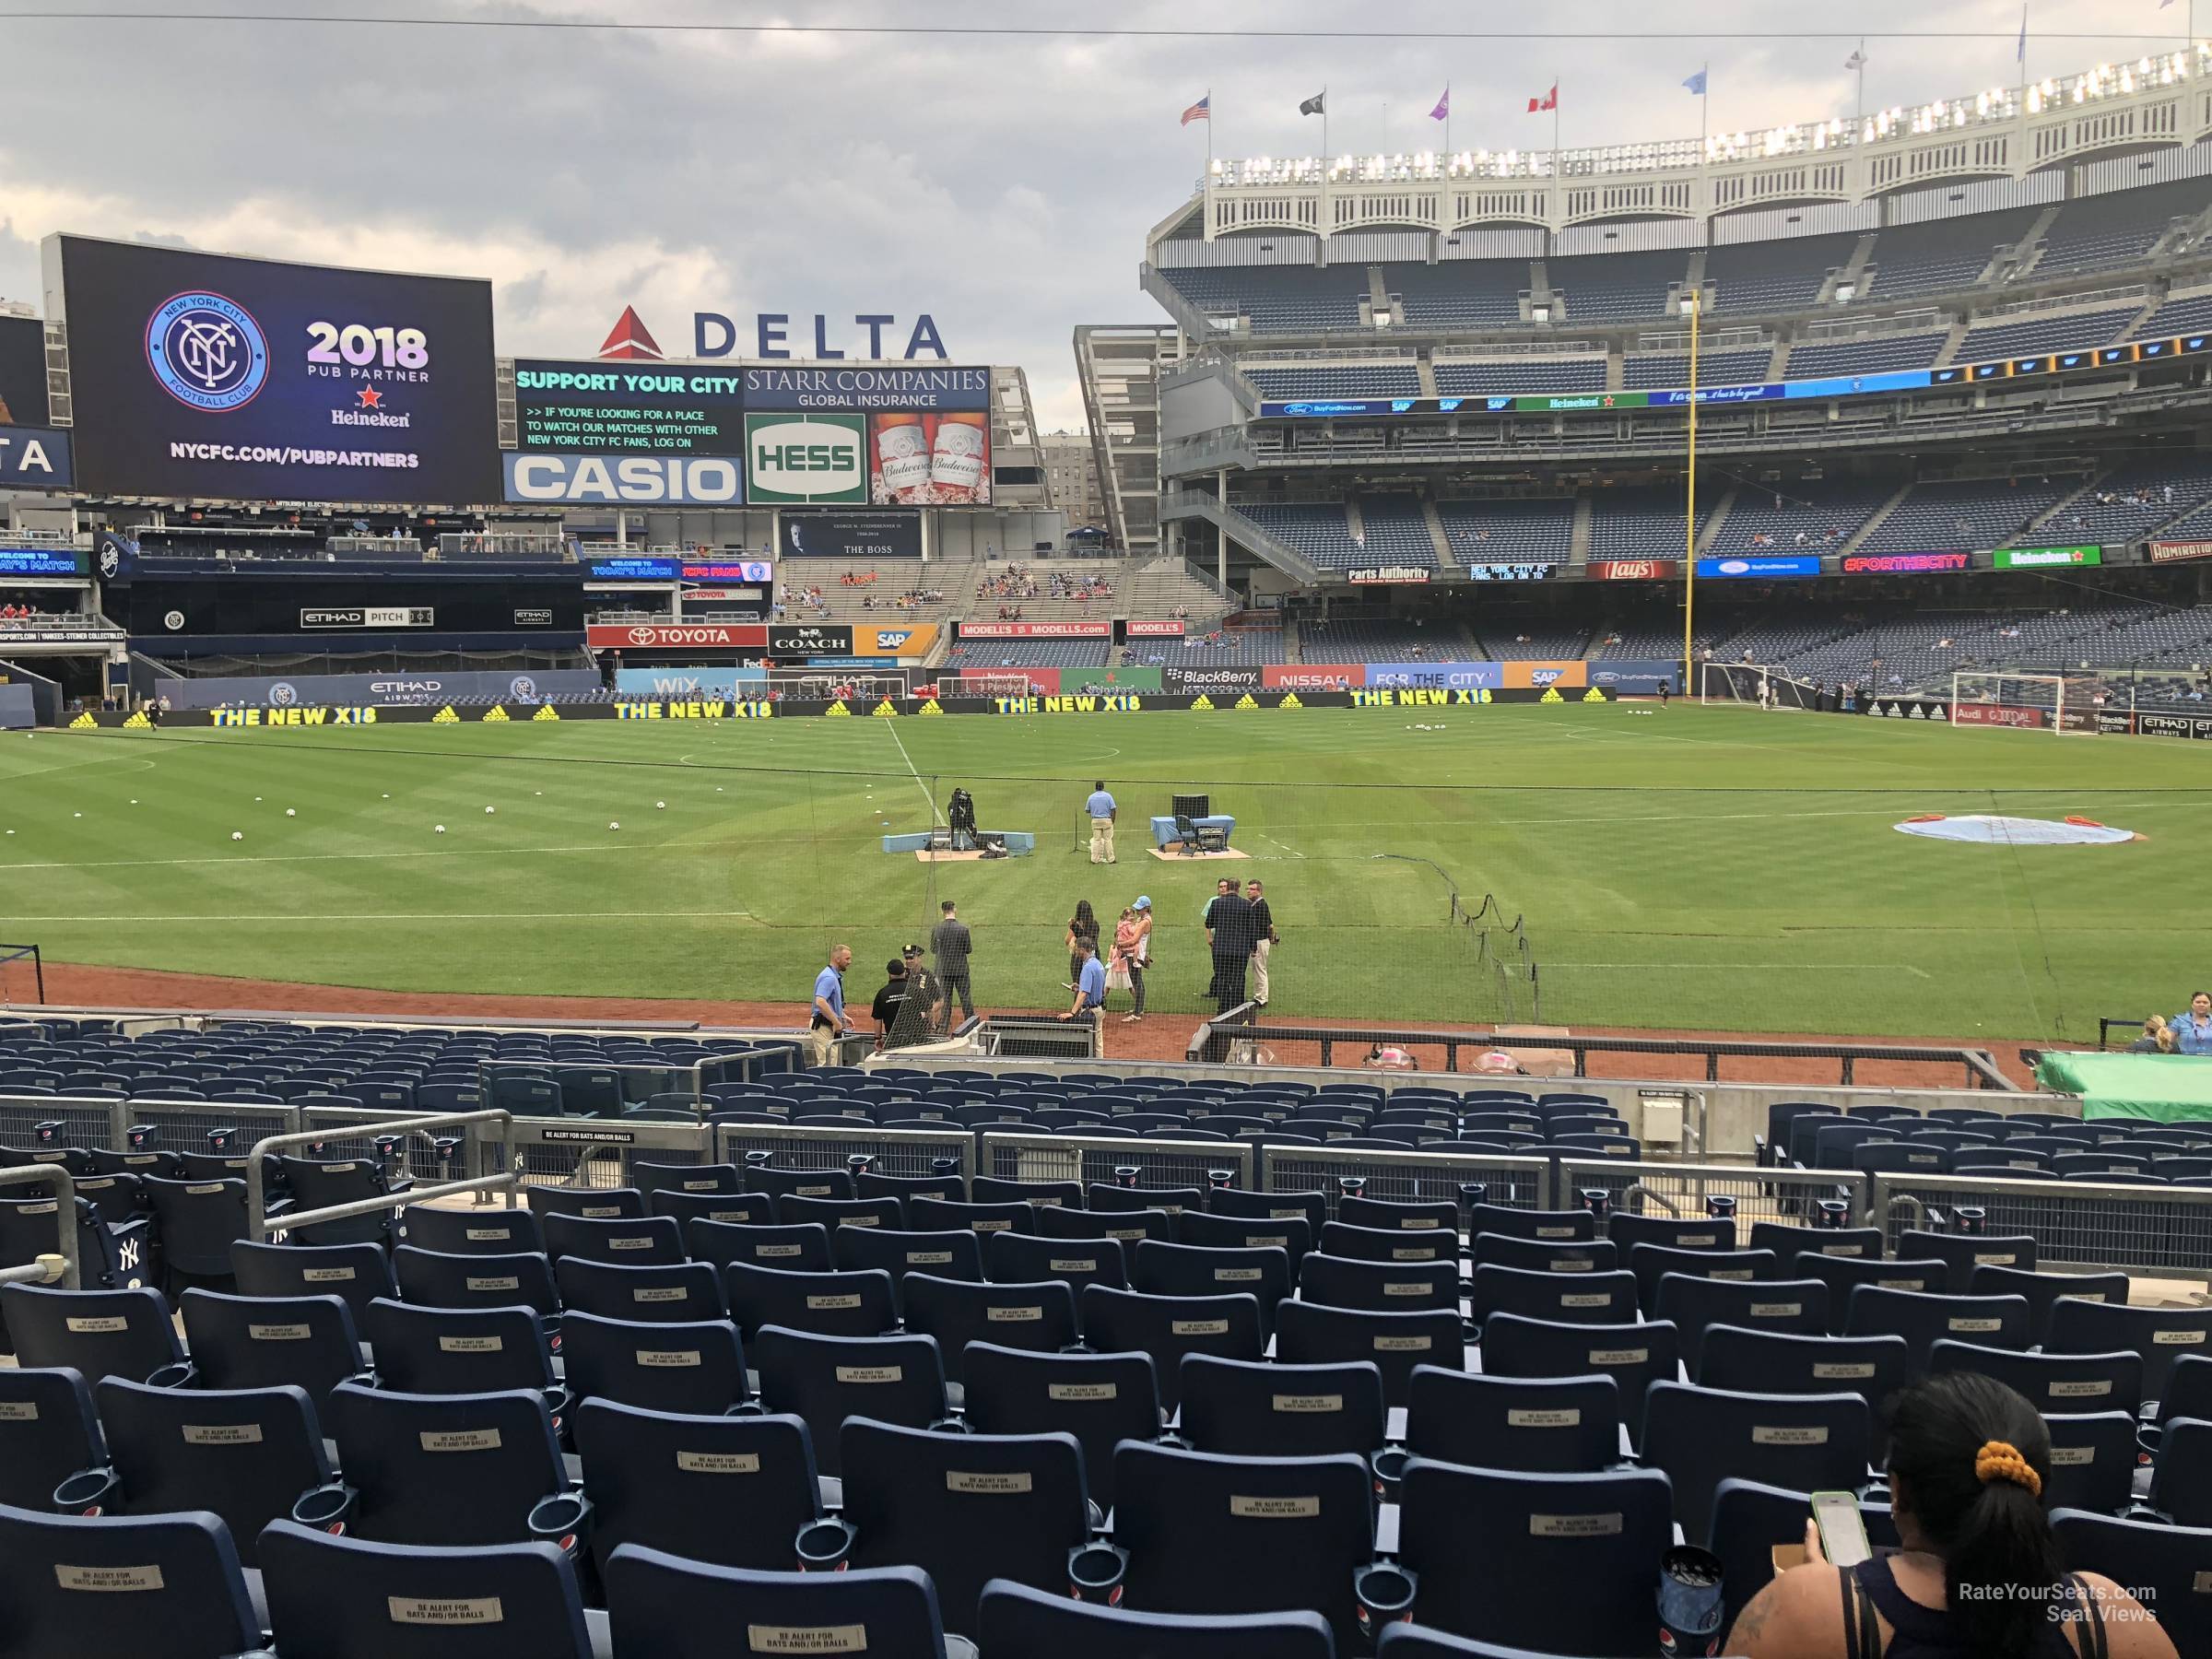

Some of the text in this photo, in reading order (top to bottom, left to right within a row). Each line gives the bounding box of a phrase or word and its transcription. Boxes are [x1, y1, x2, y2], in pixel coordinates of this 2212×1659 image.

[164, 298, 247, 324] NEW YORK CITY
[694, 312, 948, 360] DELTA
[306, 322, 429, 370] 2018
[308, 365, 429, 383] PUB PARTNER
[747, 370, 986, 392] STARR COMPANIES
[516, 371, 739, 394] SUPPORT YOUR CITY
[170, 379, 253, 406] FOOTBALL CLUB
[798, 394, 937, 406] GLOBAL INSURANCE
[1392, 402, 1409, 412] SAP
[1440, 401, 1457, 410] SAP
[1488, 400, 1505, 409] SAP
[1549, 397, 1598, 408] Heineken
[331, 409, 410, 428] Heineken
[546, 407, 704, 421] IF YOU'RE LOOKING FOR A PLACE
[526, 421, 718, 436] TO WATCH OUR MATCHES WITH OTHER
[527, 436, 691, 448] NEW YORK CITY FC FANS, LOG ON
[171, 442, 419, 468] NYCFC.COM/PUBPARTNERS
[759, 445, 854, 471] HESS
[514, 455, 736, 501] CASIO
[867, 546, 892, 554] BOSS
[30, 560, 75, 571] MATCH
[1490, 565, 1510, 573] YORK
[1513, 565, 1534, 573] CITY
[1537, 565, 1548, 573] FC
[1611, 560, 1649, 579] Lay's
[1844, 554, 1967, 571] #FORTHECITY
[638, 567, 672, 576] MATCH
[1348, 567, 1429, 580] Parts Authority
[305, 612, 404, 622] ETIHAD PITCH
[964, 625, 1105, 634] MODELL'S MODELLS.com
[1132, 623, 1179, 633] MODELL'S
[658, 629, 730, 643] TOYOTA
[877, 632, 906, 646] SAP
[775, 639, 846, 649] COACH
[744, 658, 776, 669] FedEx
[1184, 671, 1255, 685] BlackBerry
[1376, 673, 1484, 685] FOR THE CITY
[1532, 672, 1559, 684] SAP
[371, 681, 441, 692] ETIHAD
[995, 696, 1141, 712] THE NEW X18
[1350, 689, 1492, 707] THE NEW X18
[210, 706, 377, 726] THE NEW X18
[614, 701, 772, 719] THE NEW X18
[1958, 709, 1982, 719] Audi
[2145, 718, 2187, 729] ETIHAD
